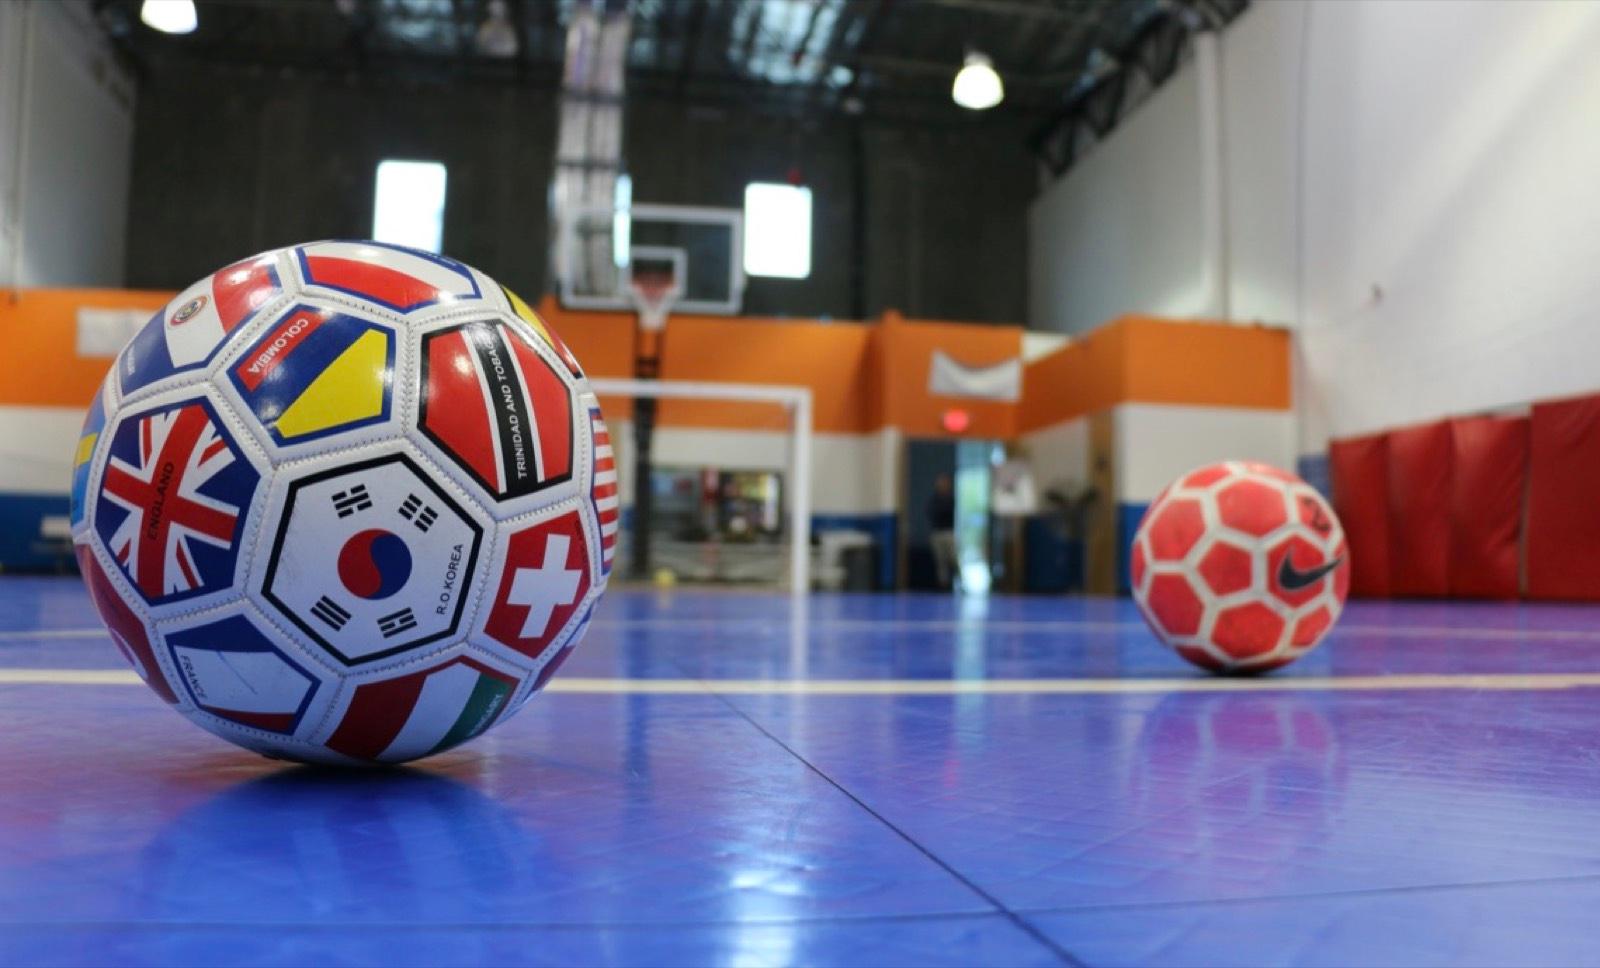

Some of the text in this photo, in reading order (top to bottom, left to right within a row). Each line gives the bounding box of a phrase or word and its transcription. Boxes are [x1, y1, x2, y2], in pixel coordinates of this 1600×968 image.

[247, 318, 309, 373] COLOMBIA
[488, 341, 528, 479] TRINIDAD AND TOBAG
[147, 462, 175, 540] ENGLAND
